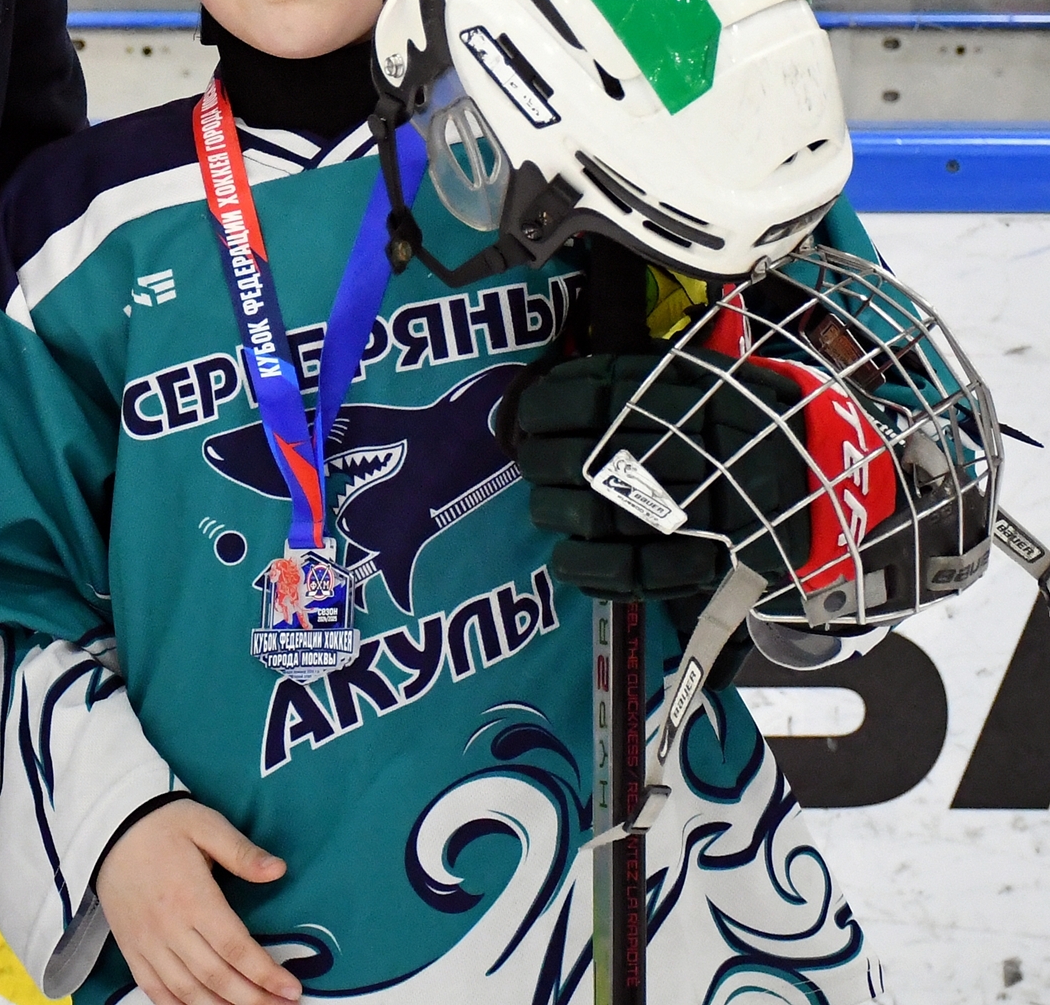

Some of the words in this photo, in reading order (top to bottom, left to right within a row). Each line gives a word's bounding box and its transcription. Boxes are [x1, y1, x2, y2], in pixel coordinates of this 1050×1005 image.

[200, 106, 227, 152] ГОРОДА
[207, 152, 240, 208] ХОККЕЯ
[220, 209, 265, 316] ФЕДЕРАЦИИ
[247, 318, 283, 379] КУБОК
[633, 493, 665, 514] BAUER
[996, 524, 1035, 556] BAUER
[931, 551, 990, 585] BAUE
[253, 632, 278, 655] КУБОК
[279, 630, 323, 650] ФЕДЕРАЦИИ
[323, 630, 353, 653] ХОККЕЯ
[267, 653, 299, 669] ГОРОДА
[301, 651, 337, 666] МОСКВЫ
[626, 637, 639, 670] THE
[260, 564, 560, 779] АКУЛЫ
[672, 669, 698, 719] BAUER
[626, 673, 639, 768] QUICKNESS
[626, 886, 639, 909] LA
